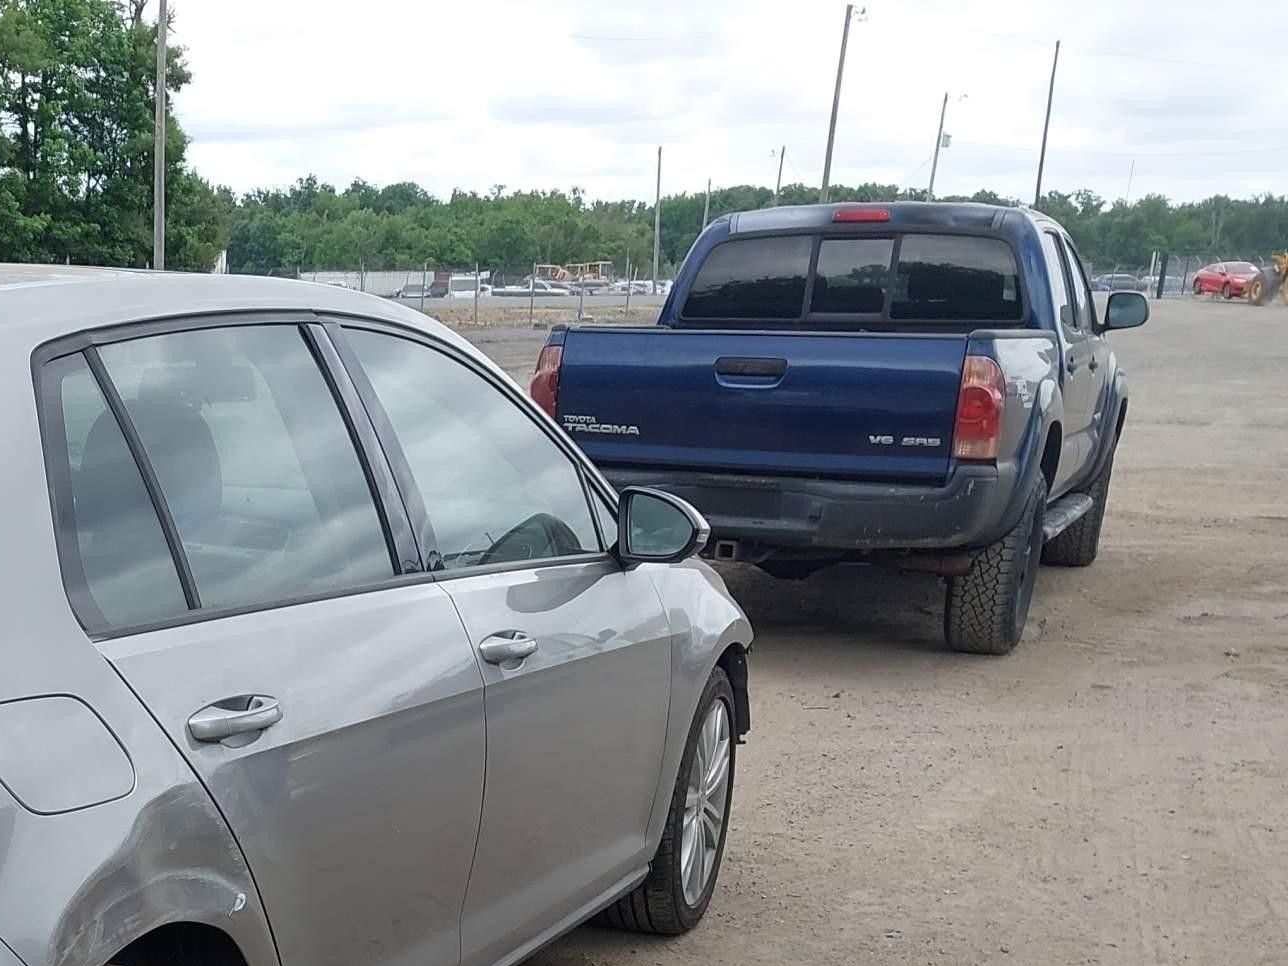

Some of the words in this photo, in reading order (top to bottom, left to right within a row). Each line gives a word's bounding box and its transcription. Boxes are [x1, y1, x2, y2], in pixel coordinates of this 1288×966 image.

[563, 415, 597, 424] TOYOTA
[563, 424, 640, 436] TACOMA
[868, 435, 894, 445] V6
[901, 437, 941, 447] SR5
